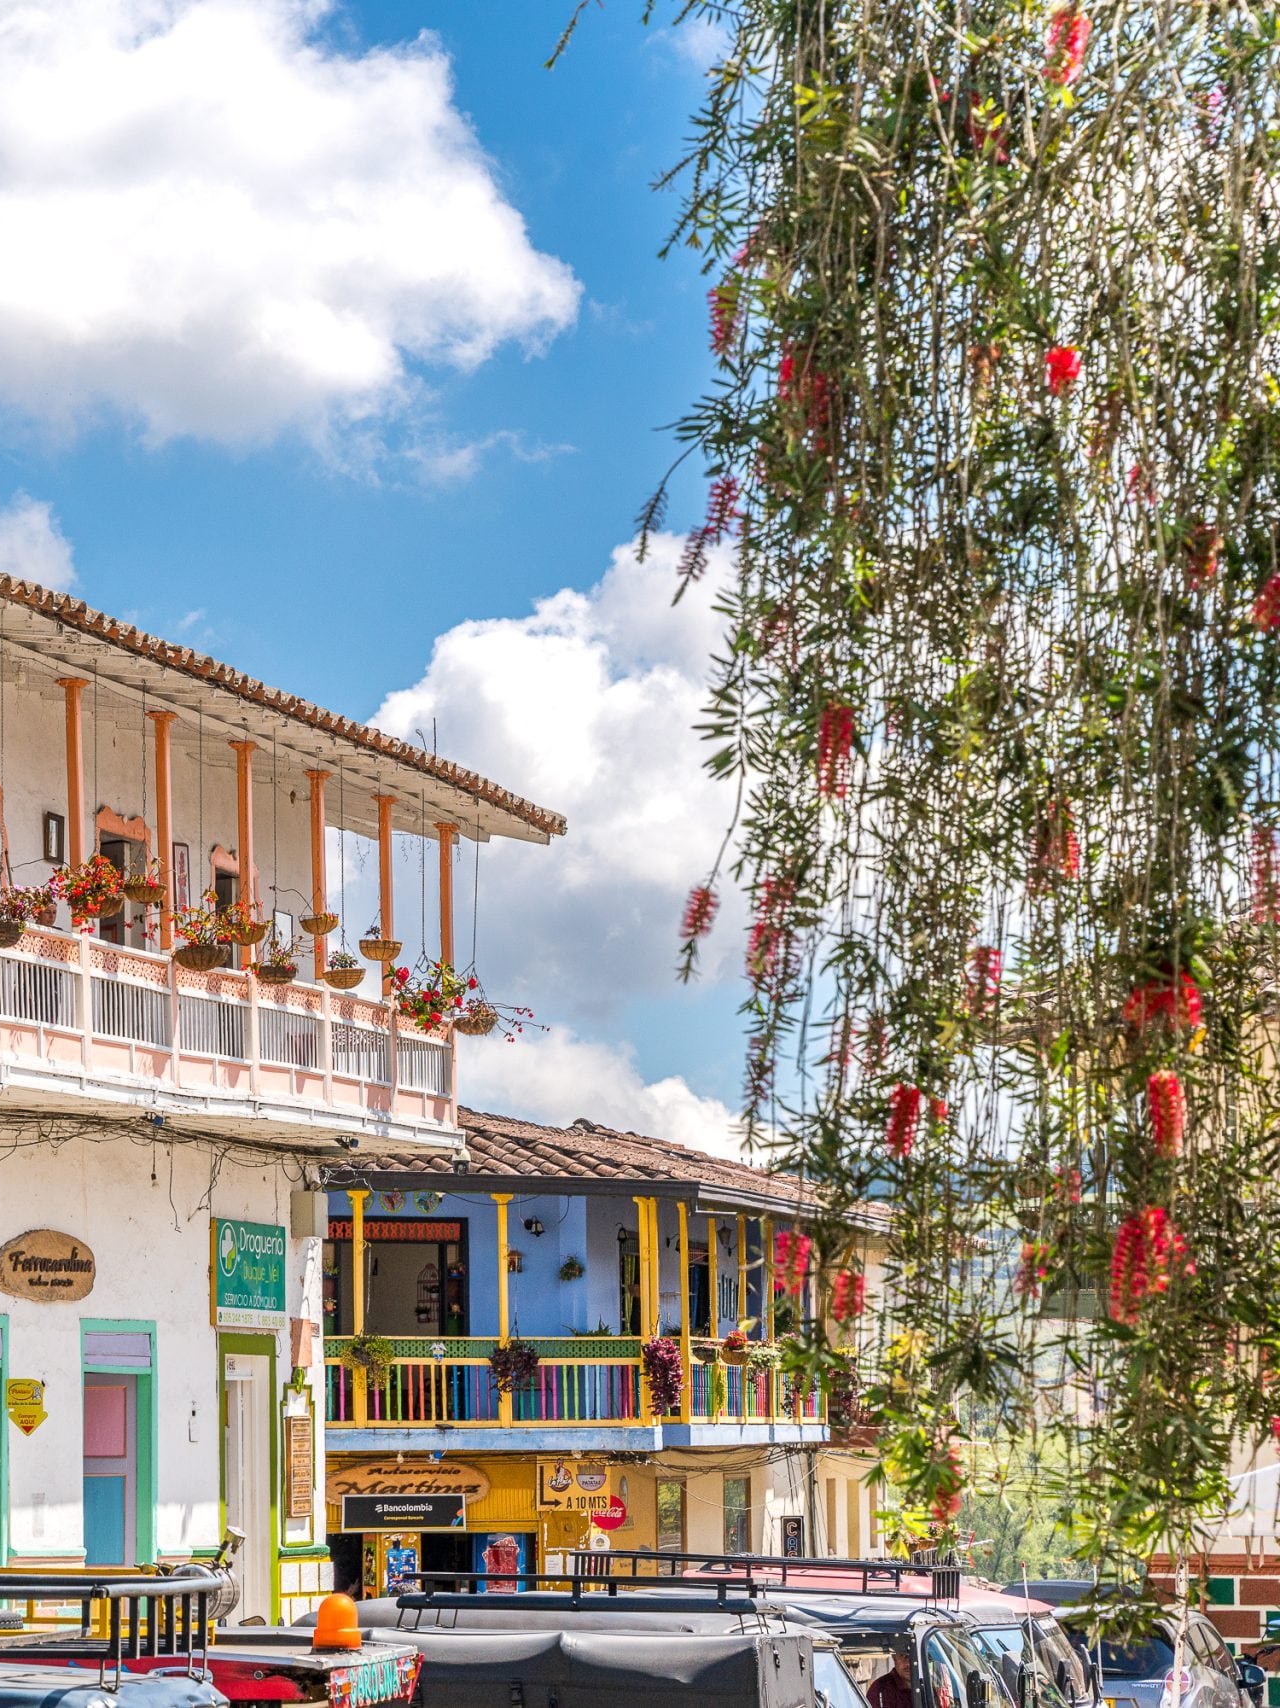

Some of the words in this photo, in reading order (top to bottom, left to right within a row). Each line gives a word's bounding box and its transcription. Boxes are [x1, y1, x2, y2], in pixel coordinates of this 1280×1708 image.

[240, 1227, 283, 1259] Droguería
[224, 1293, 248, 1306] SERVICIO
[367, 1466, 462, 1476] Autoservicio
[383, 1503, 433, 1513] Bancolombia
[566, 1496, 572, 1509] A
[576, 1496, 585, 1509] 10
[588, 1496, 607, 1509] MTS
